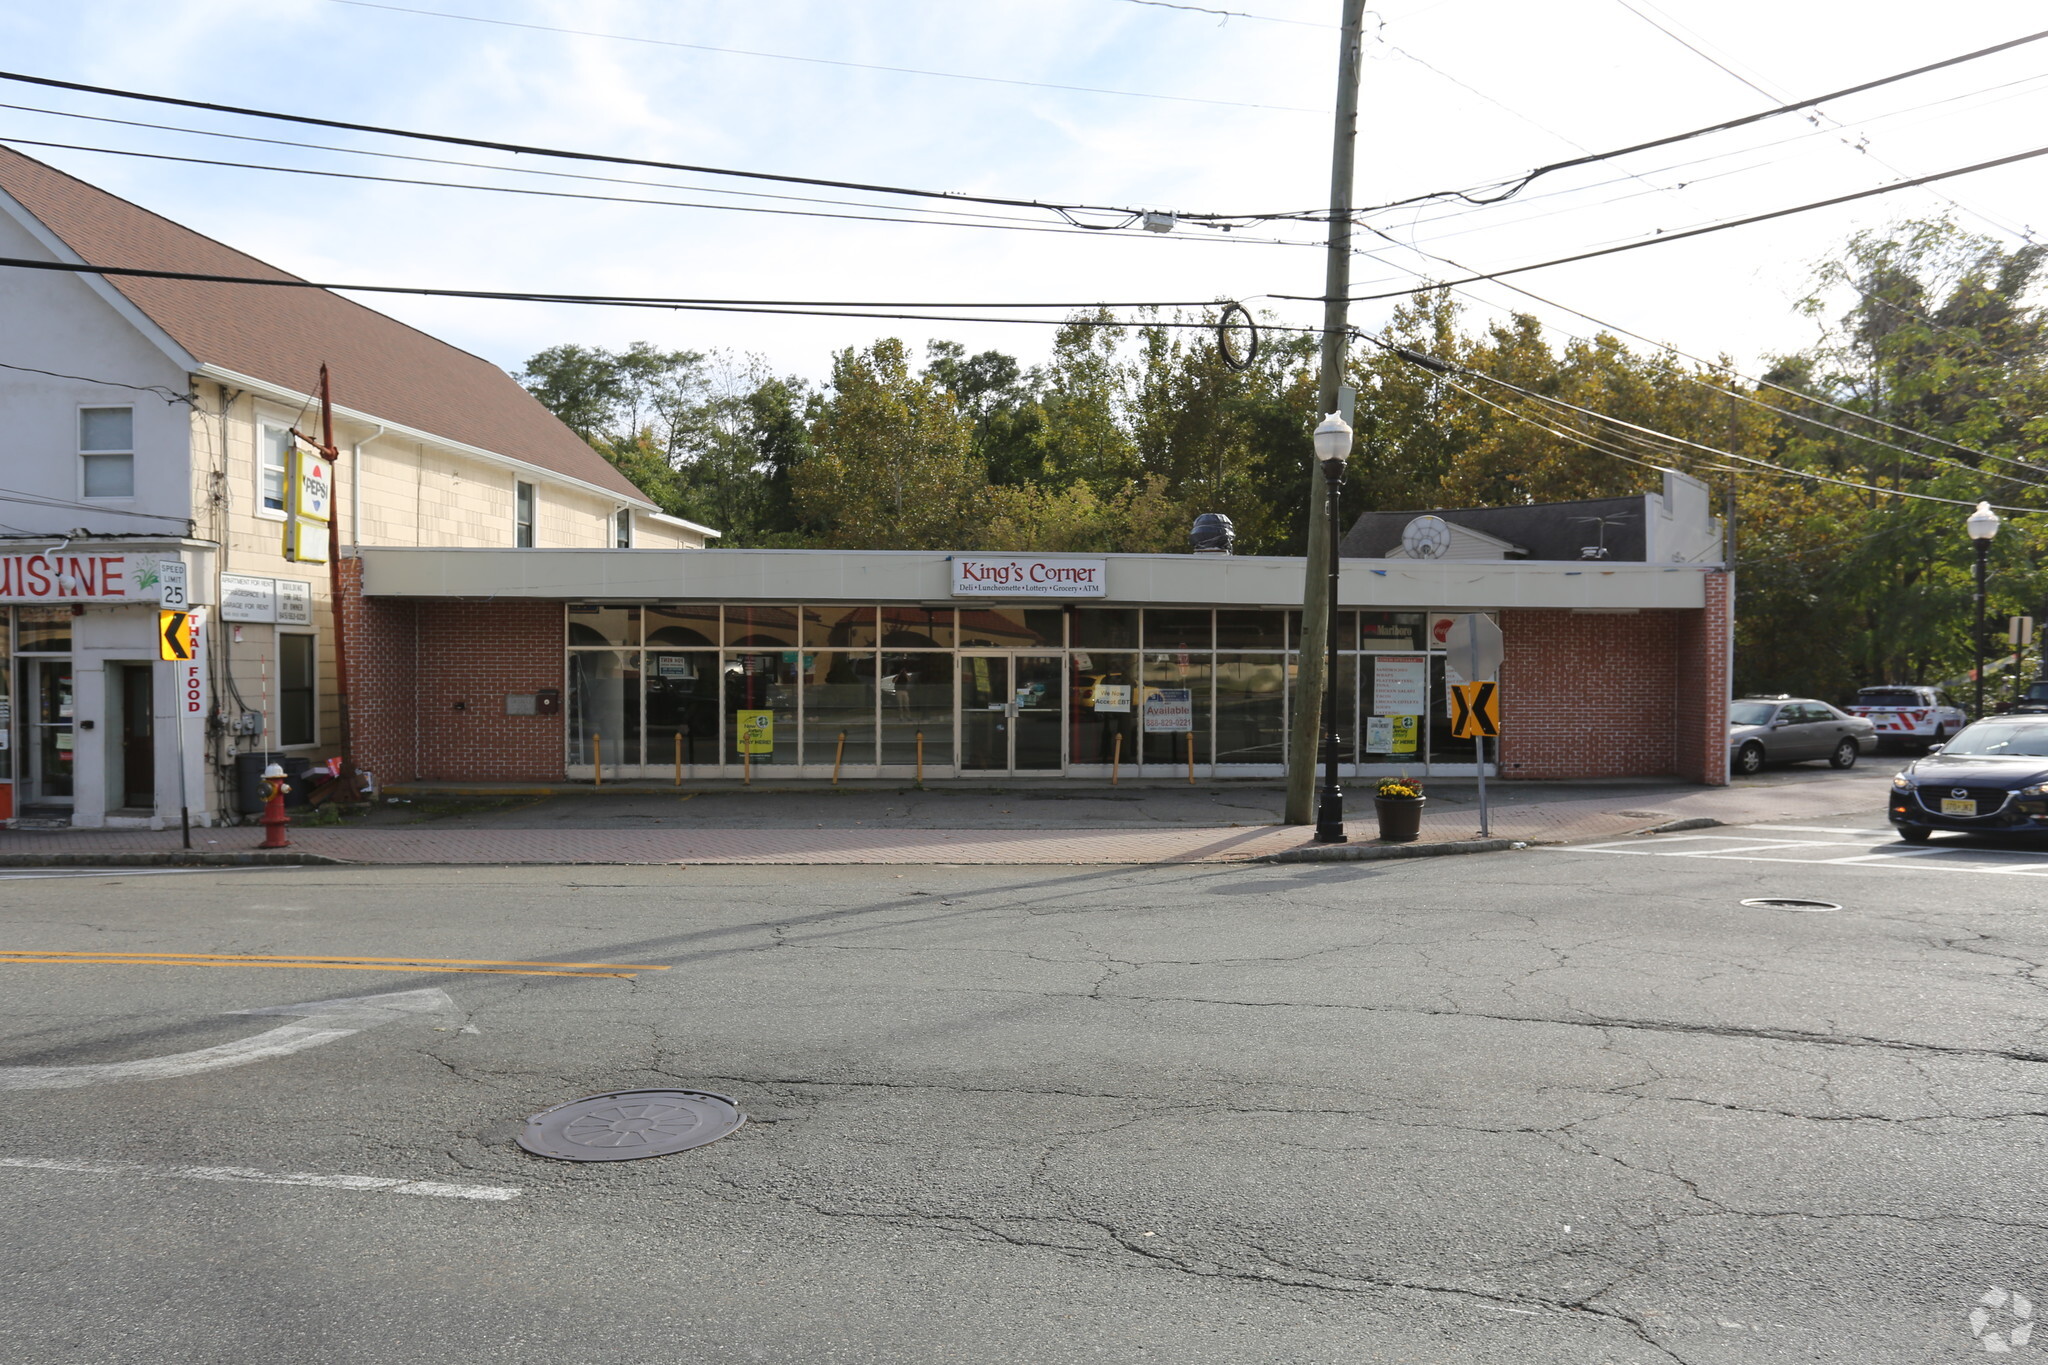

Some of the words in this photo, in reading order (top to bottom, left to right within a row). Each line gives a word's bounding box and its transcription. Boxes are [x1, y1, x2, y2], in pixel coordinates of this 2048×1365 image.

[305, 477, 329, 499] PEPSI
[161, 564, 184, 574] SPEED
[962, 562, 1024, 584] King's
[1030, 563, 1096, 583] Corner
[164, 576, 182, 584] LIMIT
[1053, 585, 1077, 593] Grocery
[164, 586, 183, 604] 25
[223, 601, 242, 609] GARAGE
[1377, 625, 1412, 636] Marlboro
[188, 615, 200, 660] THAI
[187, 667, 200, 712] FOOD
[1095, 698, 1116, 706] Accept
[1147, 706, 1190, 715] Available
